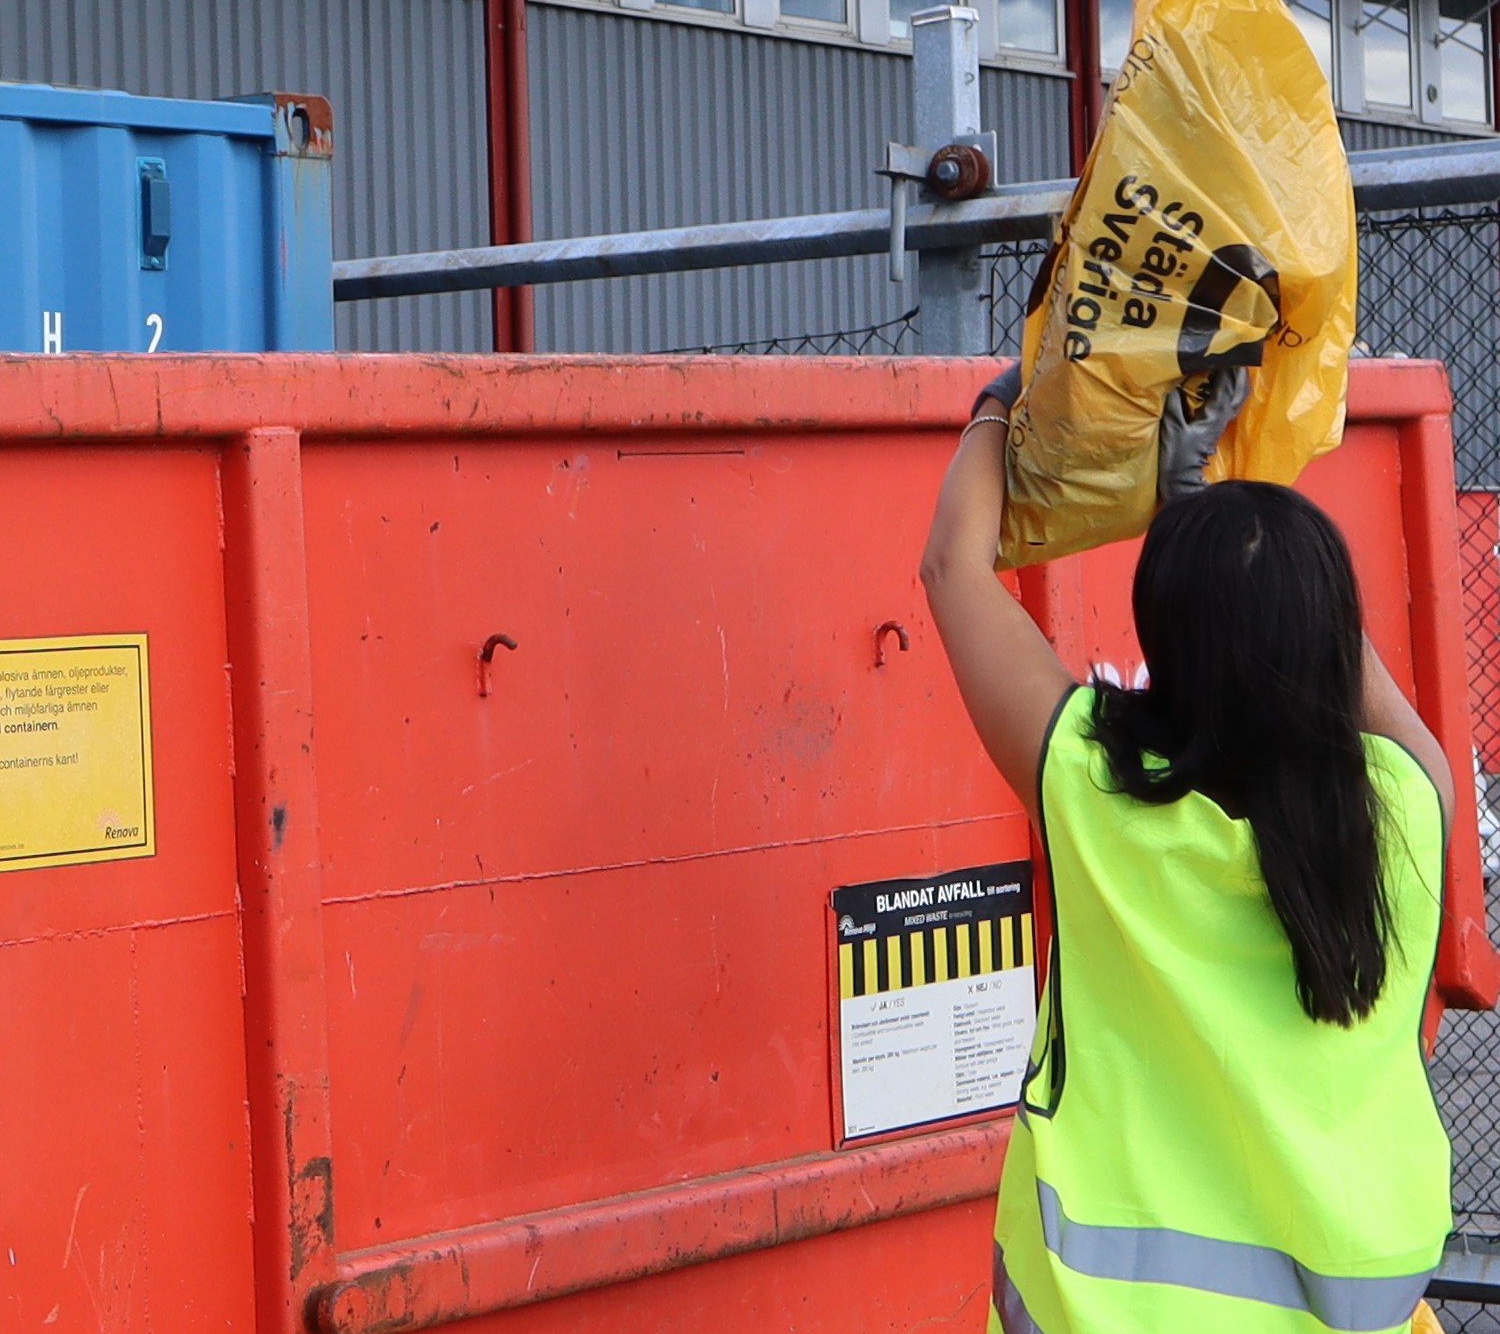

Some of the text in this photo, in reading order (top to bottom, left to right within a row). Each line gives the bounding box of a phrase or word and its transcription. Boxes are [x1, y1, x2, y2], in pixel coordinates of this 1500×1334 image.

[1064, 174, 1159, 363] Sverige
[1121, 201, 1205, 329] Städa
[90, 682, 109, 694] eller
[104, 826, 139, 840] Renova
[876, 886, 935, 913] BLANDAT
[937, 880, 985, 904] AVFALL
[926, 910, 948, 923] WASTE
